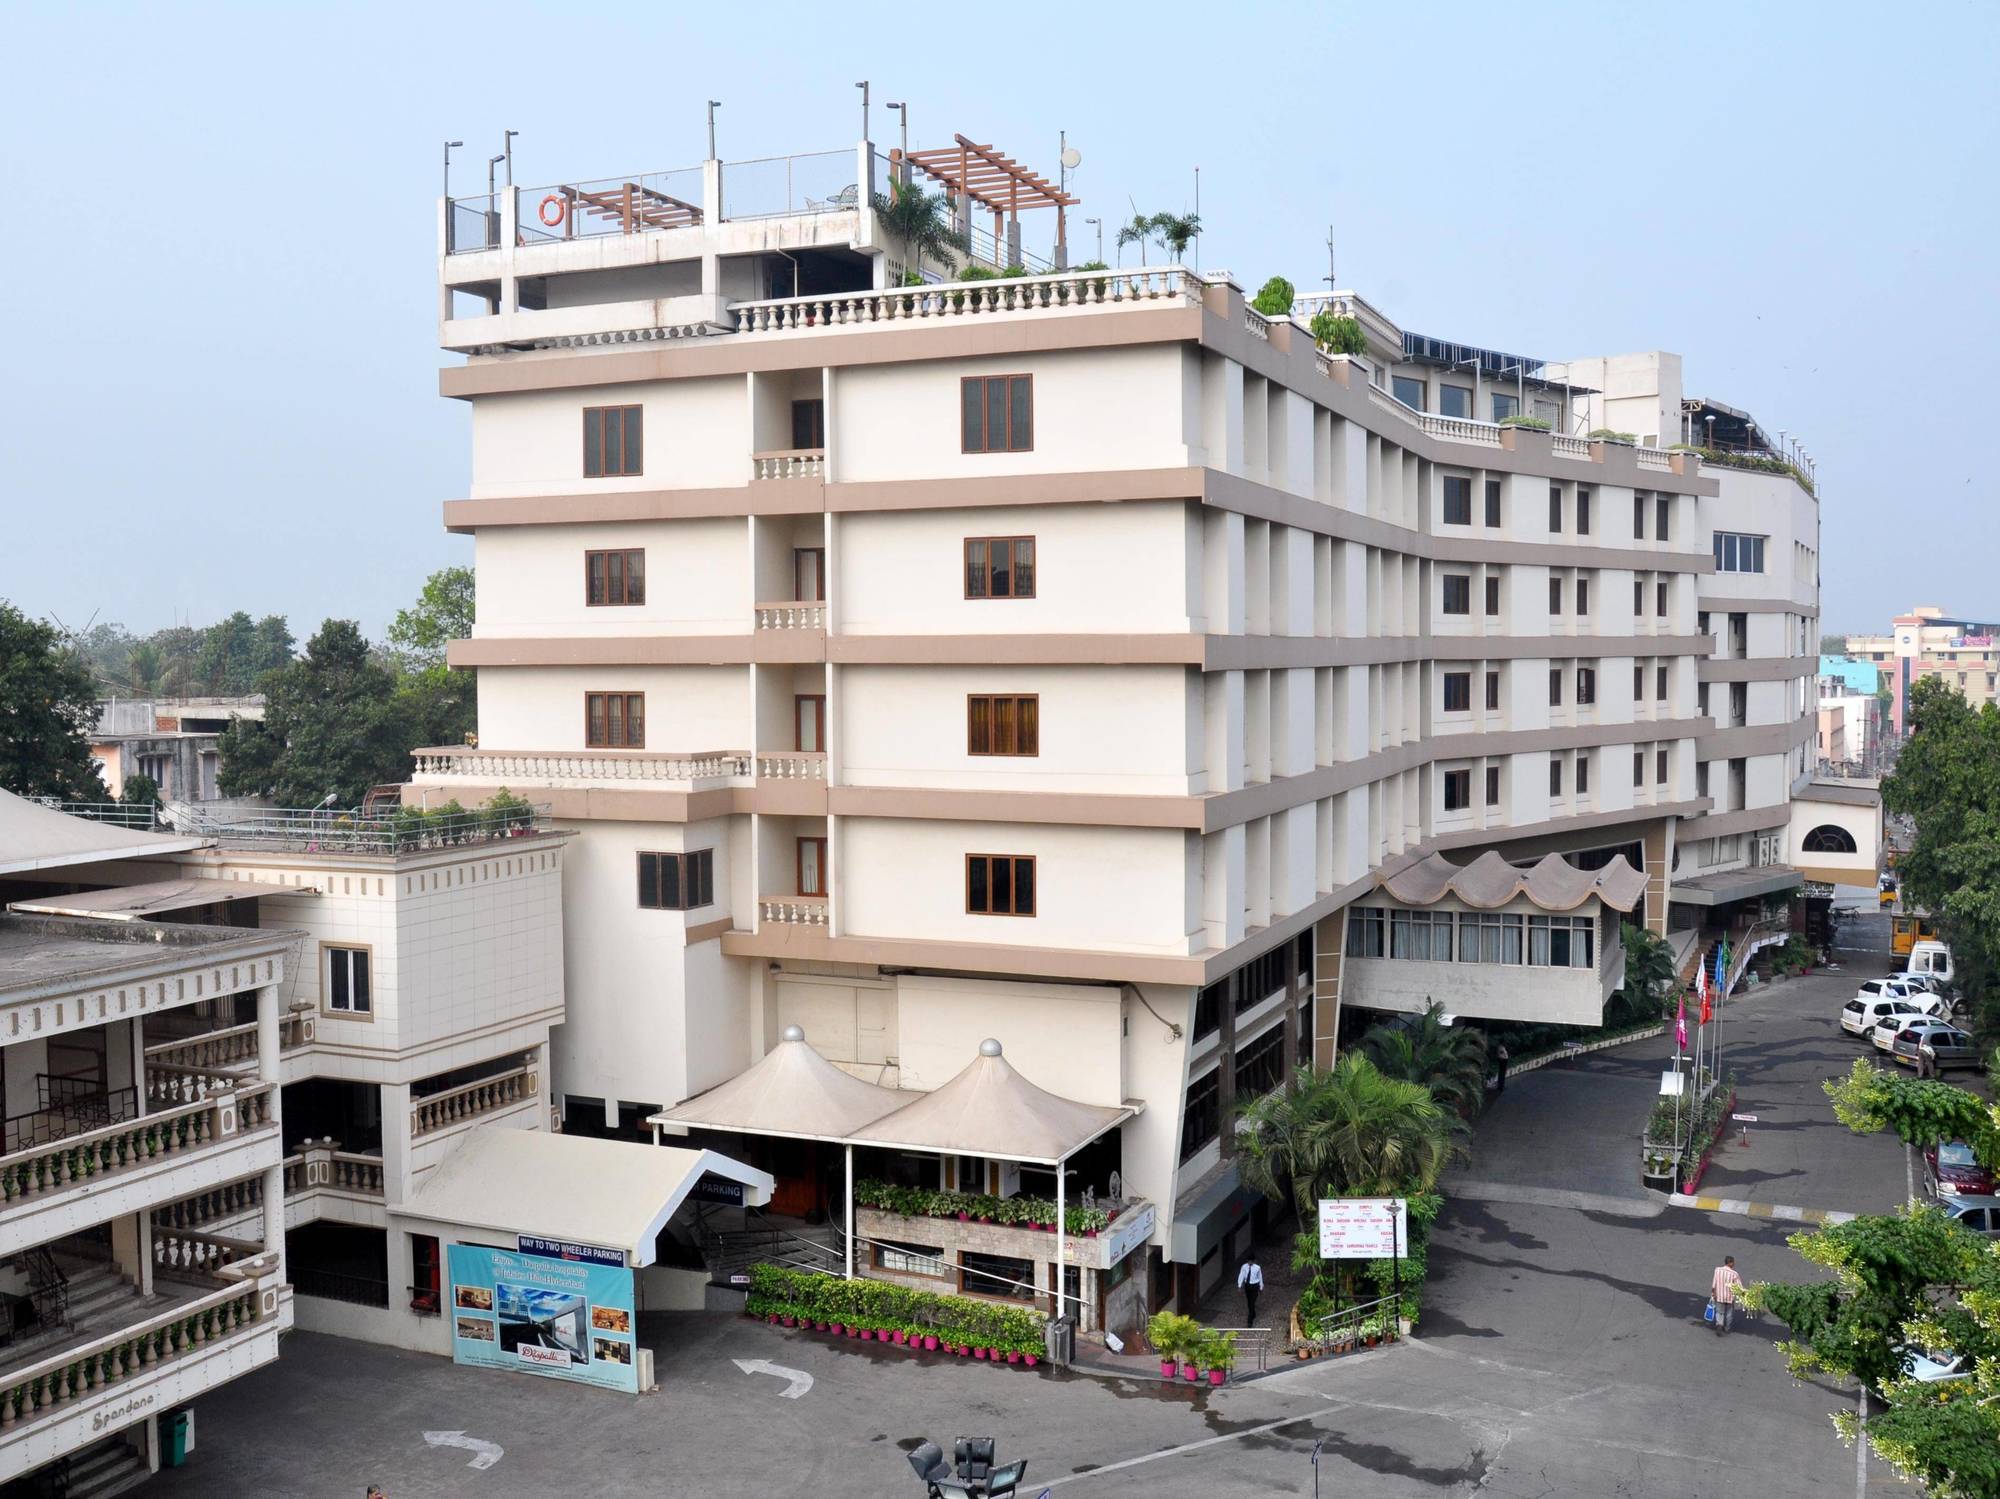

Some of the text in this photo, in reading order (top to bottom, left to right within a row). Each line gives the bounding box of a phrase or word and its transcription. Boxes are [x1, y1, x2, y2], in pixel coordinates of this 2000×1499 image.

[703, 1183, 741, 1197] PARKING
[520, 1238, 534, 1248] WAY
[535, 1240, 545, 1250] TO
[545, 1241, 560, 1252] TWO
[561, 1244, 592, 1257] WHEELER
[593, 1250, 622, 1261] PARKING
[93, 1395, 154, 1431] Spandana
